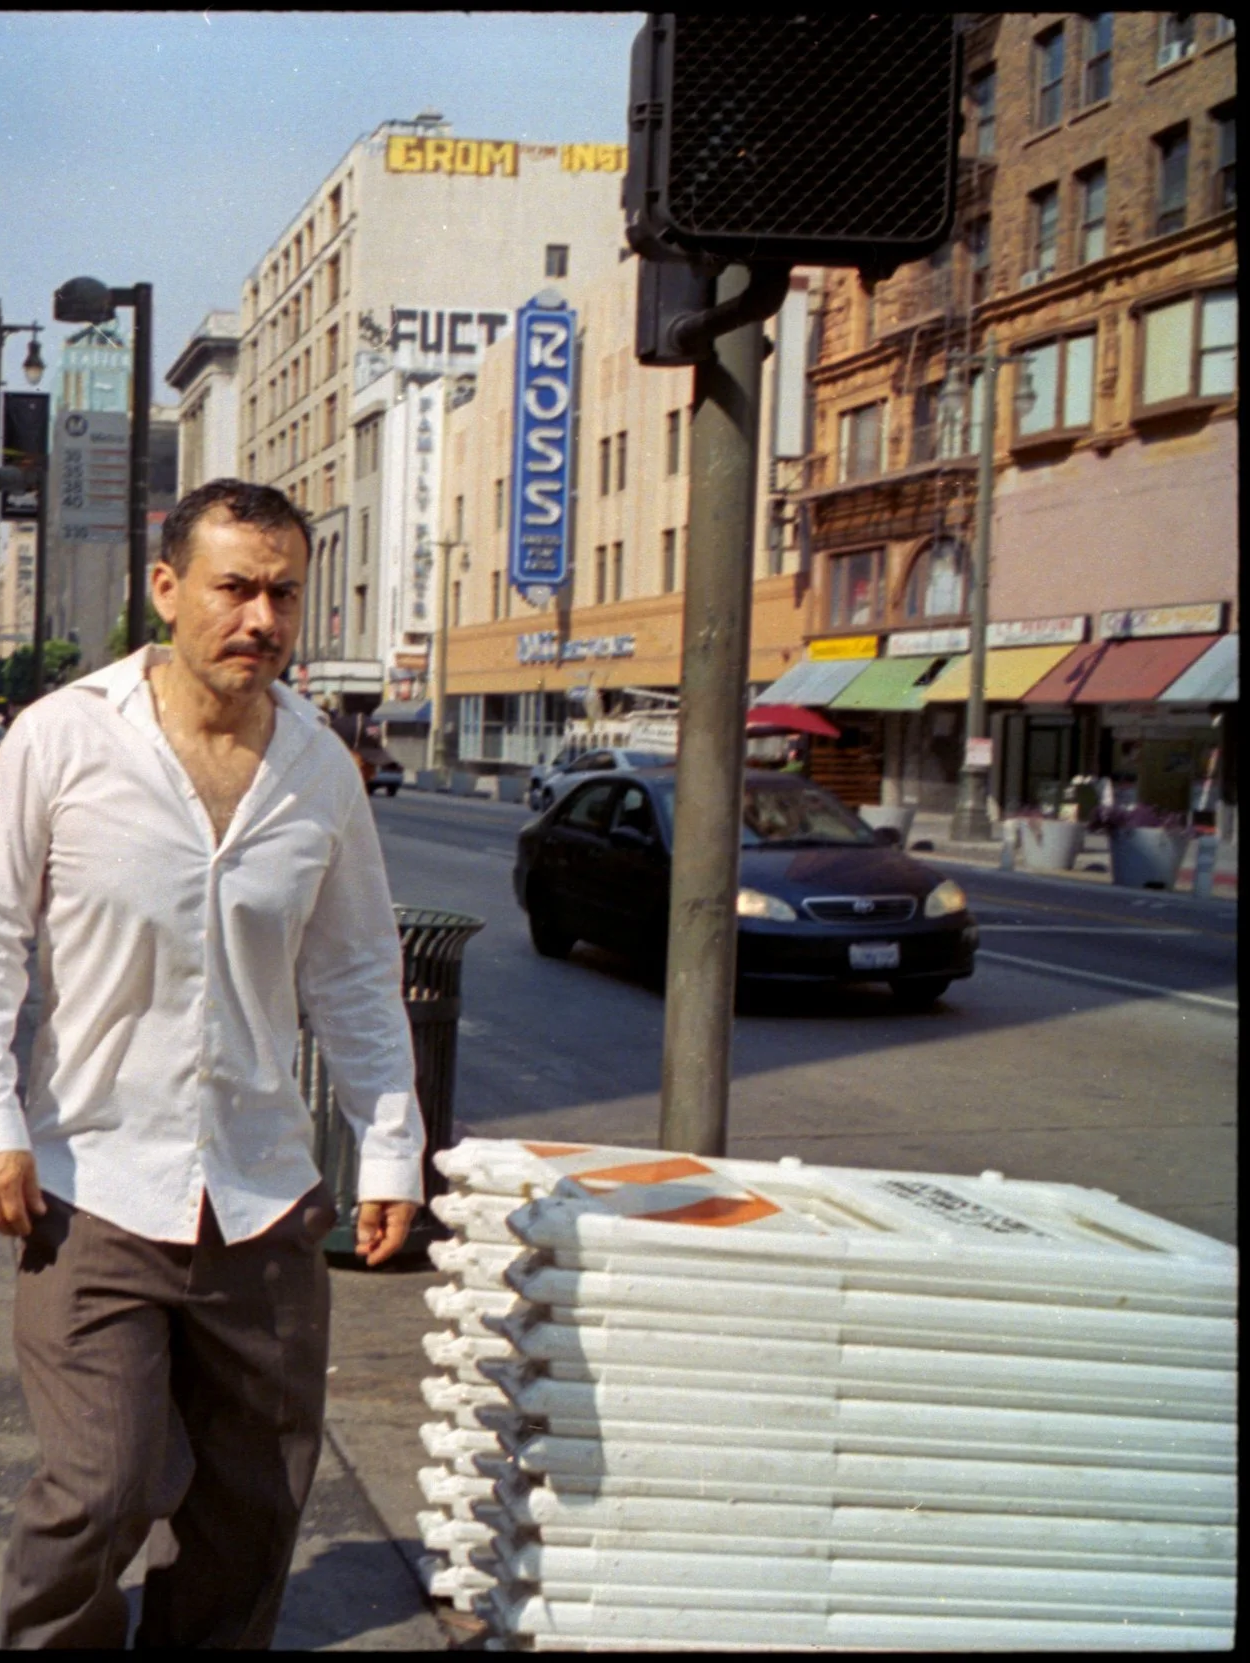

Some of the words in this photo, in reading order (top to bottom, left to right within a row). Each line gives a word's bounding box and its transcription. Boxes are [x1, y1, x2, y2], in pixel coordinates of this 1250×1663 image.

[385, 135, 519, 176] GROM
[386, 308, 508, 354] FUCT
[523, 322, 569, 526] ROSS
